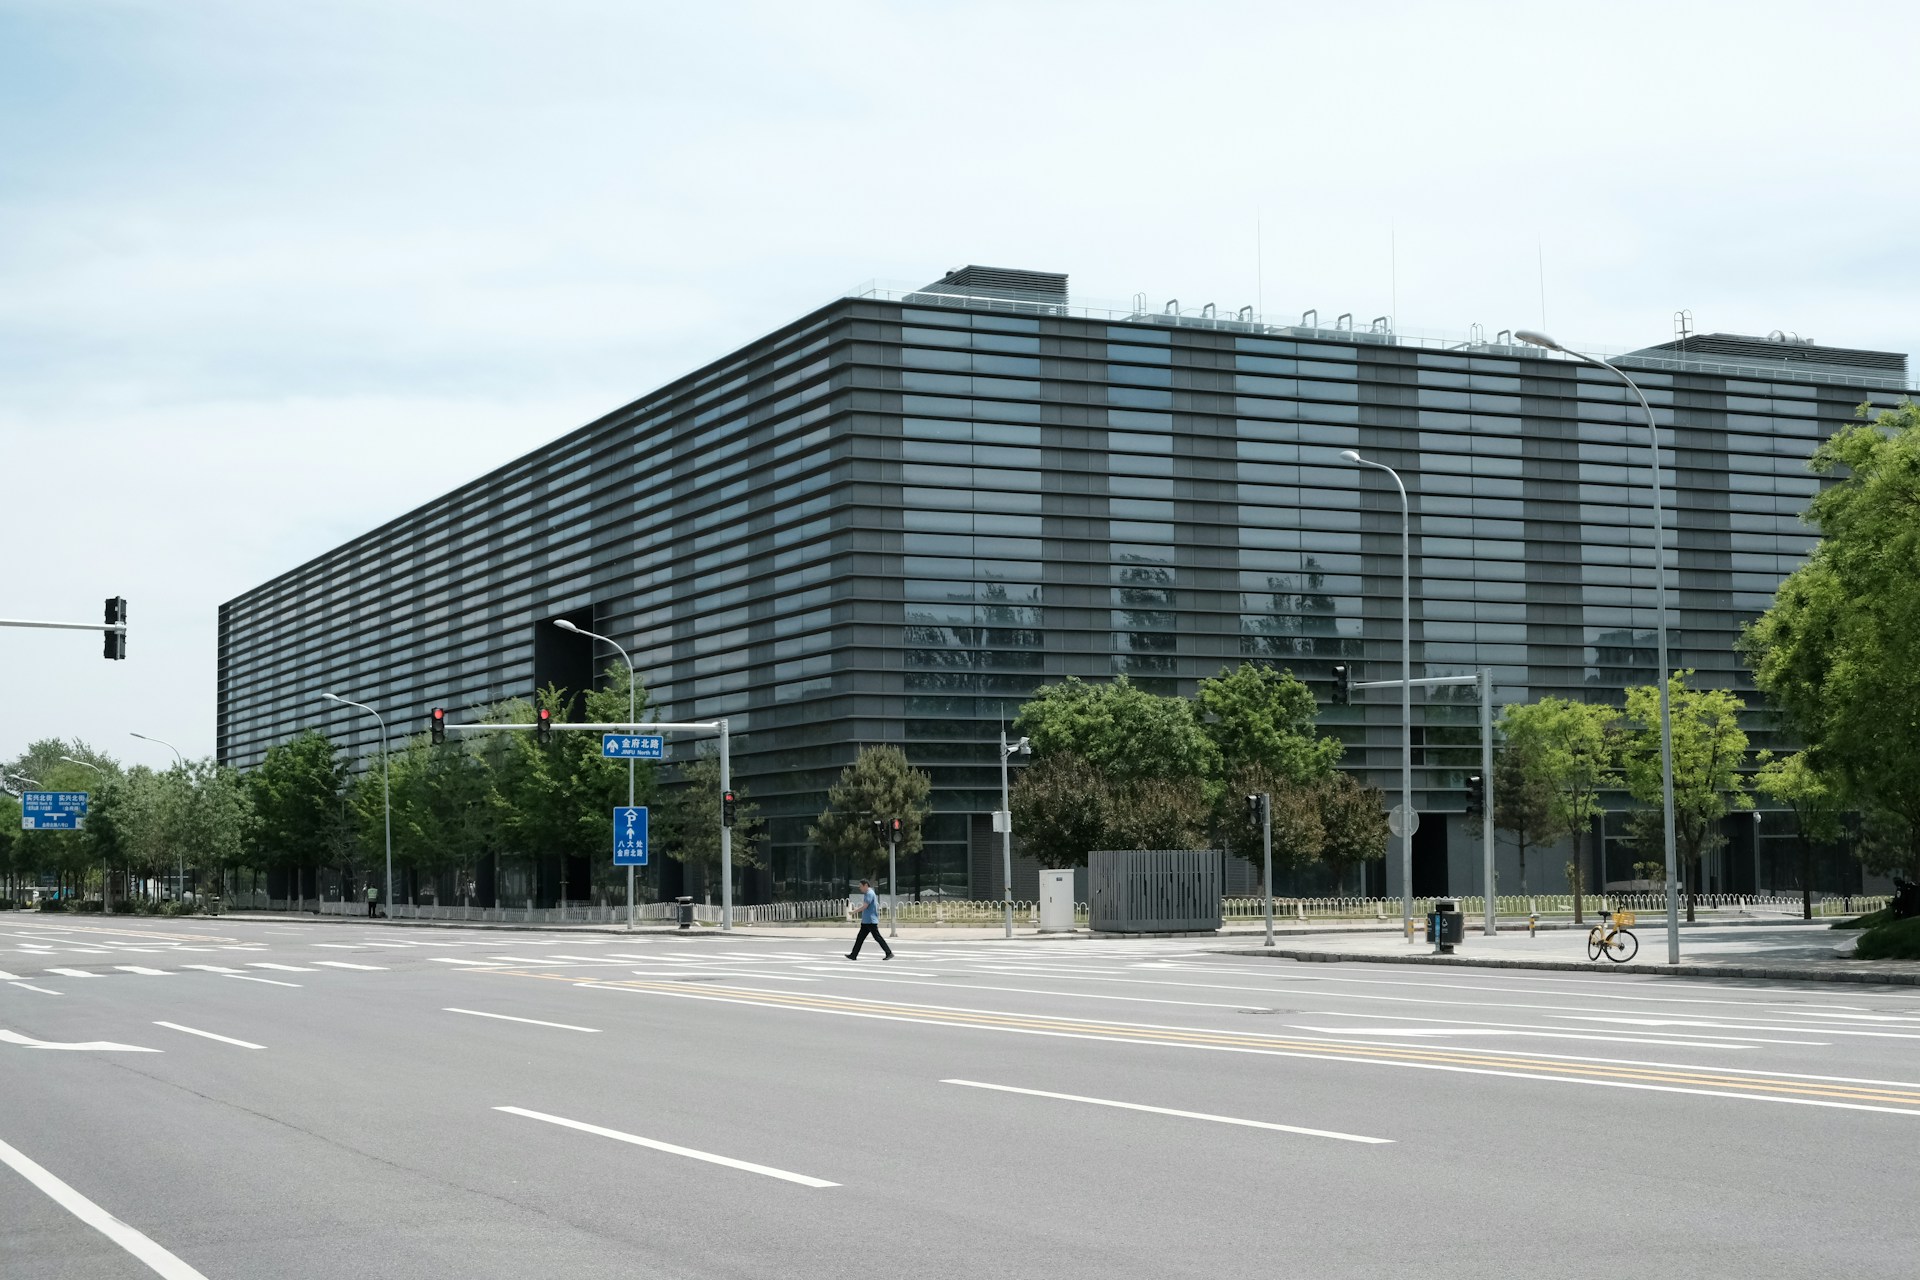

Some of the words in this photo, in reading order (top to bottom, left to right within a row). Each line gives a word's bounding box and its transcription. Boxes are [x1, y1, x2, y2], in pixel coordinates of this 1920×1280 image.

[621, 738, 659, 749] 金府北路
[626, 815, 637, 827] P
[618, 840, 643, 848] 八大处
[617, 848, 643, 857] 金府北路
